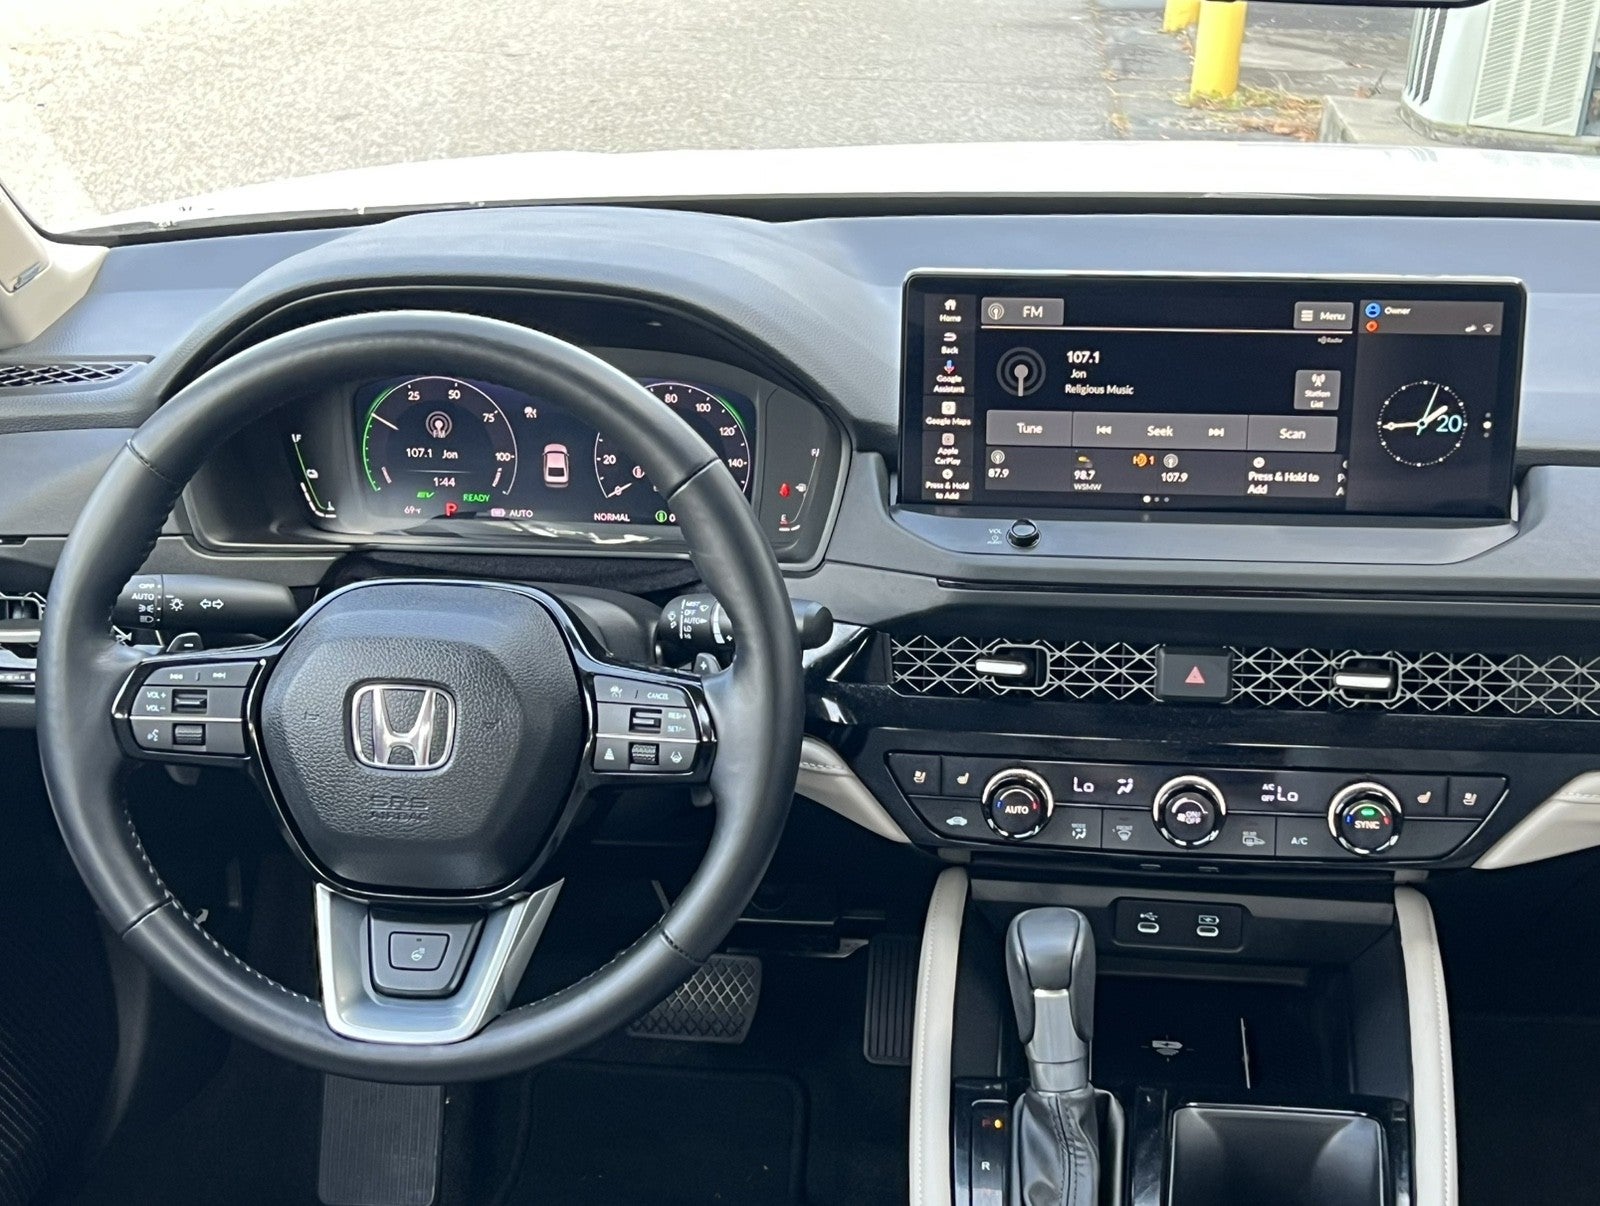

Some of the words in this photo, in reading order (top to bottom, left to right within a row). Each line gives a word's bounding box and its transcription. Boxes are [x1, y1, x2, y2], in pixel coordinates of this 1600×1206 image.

[1022, 305, 1043, 318] FM
[1320, 310, 1346, 321] Menu
[1384, 306, 1411, 315] Owner
[939, 314, 961, 322] Home
[941, 346, 959, 354] Back
[1066, 350, 1100, 364] 107.1
[936, 374, 962, 384] Google
[1070, 369, 1087, 380] Jon
[448, 390, 461, 400] 50
[1064, 384, 1105, 396] Religious
[1106, 384, 1134, 395] Music
[1304, 389, 1331, 398] Station
[408, 391, 420, 400] 25
[664, 394, 678, 403] 80
[695, 404, 711, 412] 100
[1310, 400, 1324, 409] List
[482, 413, 495, 422] 75
[926, 416, 950, 426] Google
[1016, 422, 1043, 434] Tune
[1436, 414, 1463, 432] 20
[719, 427, 734, 436] 120
[1147, 426, 1174, 437] Seek
[1280, 428, 1306, 440] Scan
[406, 448, 432, 458] 107.1
[442, 450, 458, 460] Jon
[495, 452, 511, 462] 100
[602, 455, 616, 464] 20
[728, 458, 743, 468] 140
[988, 468, 1010, 478] 87.9
[1074, 470, 1096, 480] 98.7
[1161, 472, 1188, 482] 107.9
[1248, 472, 1274, 482] Press
[1274, 473, 1283, 482] &
[1284, 472, 1308, 483] Hold
[1309, 474, 1320, 483] to
[434, 477, 456, 488] 1:44
[1247, 485, 1268, 495] Add
[463, 494, 490, 502] READY
[446, 502, 458, 516] P
[510, 508, 534, 518] AUTO
[594, 512, 631, 522] NORMAL
[647, 692, 669, 700] CANCEL
[1004, 805, 1029, 815] AUTO
[1354, 820, 1380, 830] SYNC
[1290, 836, 1308, 846] A/C
[981, 1161, 990, 1171] R
